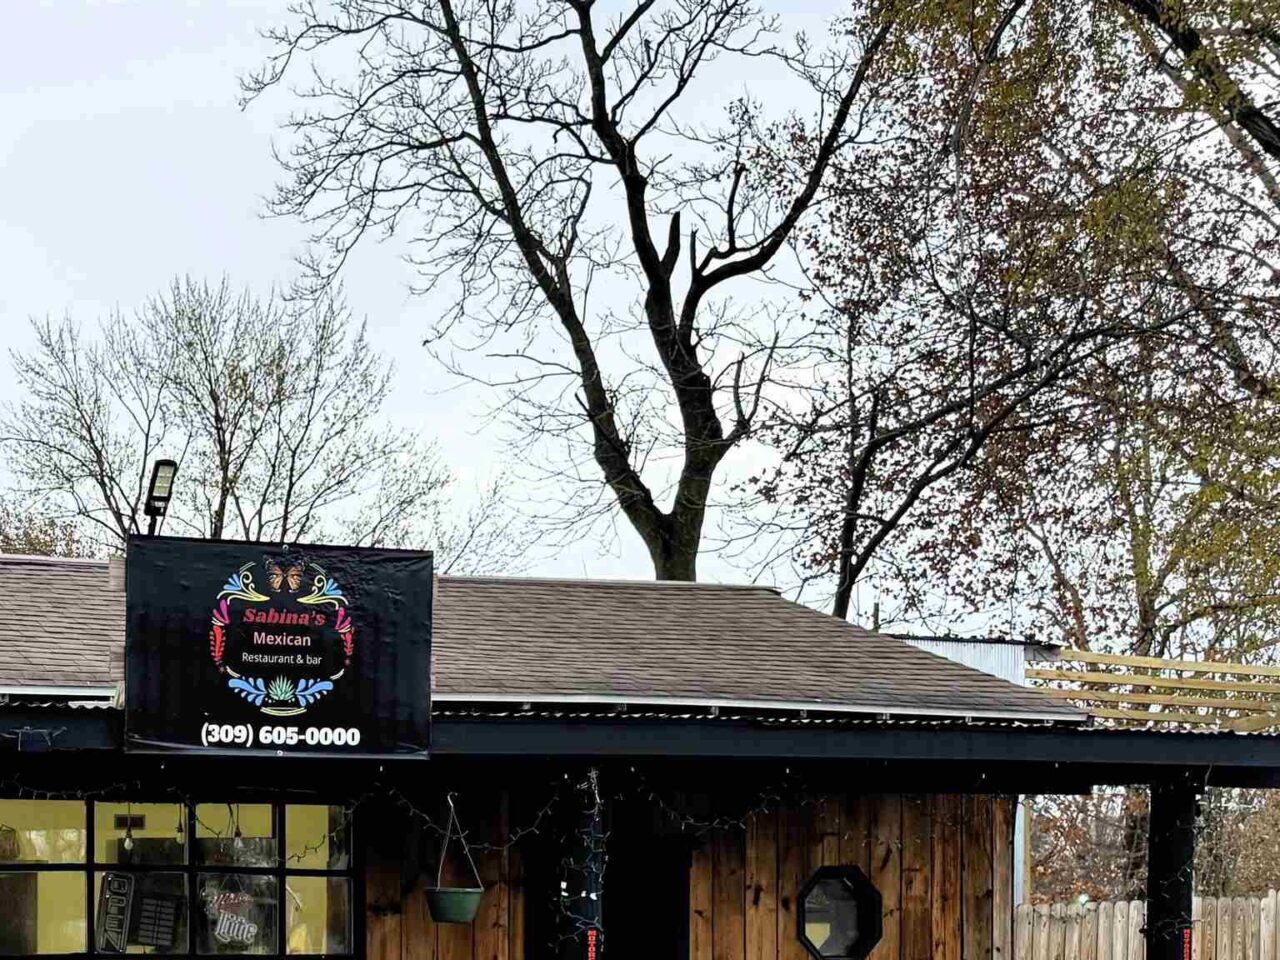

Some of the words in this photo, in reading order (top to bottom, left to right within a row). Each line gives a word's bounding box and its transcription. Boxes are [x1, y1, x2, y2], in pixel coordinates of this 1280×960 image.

[242, 608, 327, 626] Sabina's
[253, 631, 312, 647] Mexican
[241, 652, 295, 665] Restaurant
[296, 654, 305, 665] &
[306, 653, 323, 666] bar
[201, 722, 254, 747] (309)
[258, 726, 361, 746] 605-0000
[104, 877, 129, 951] OPEN
